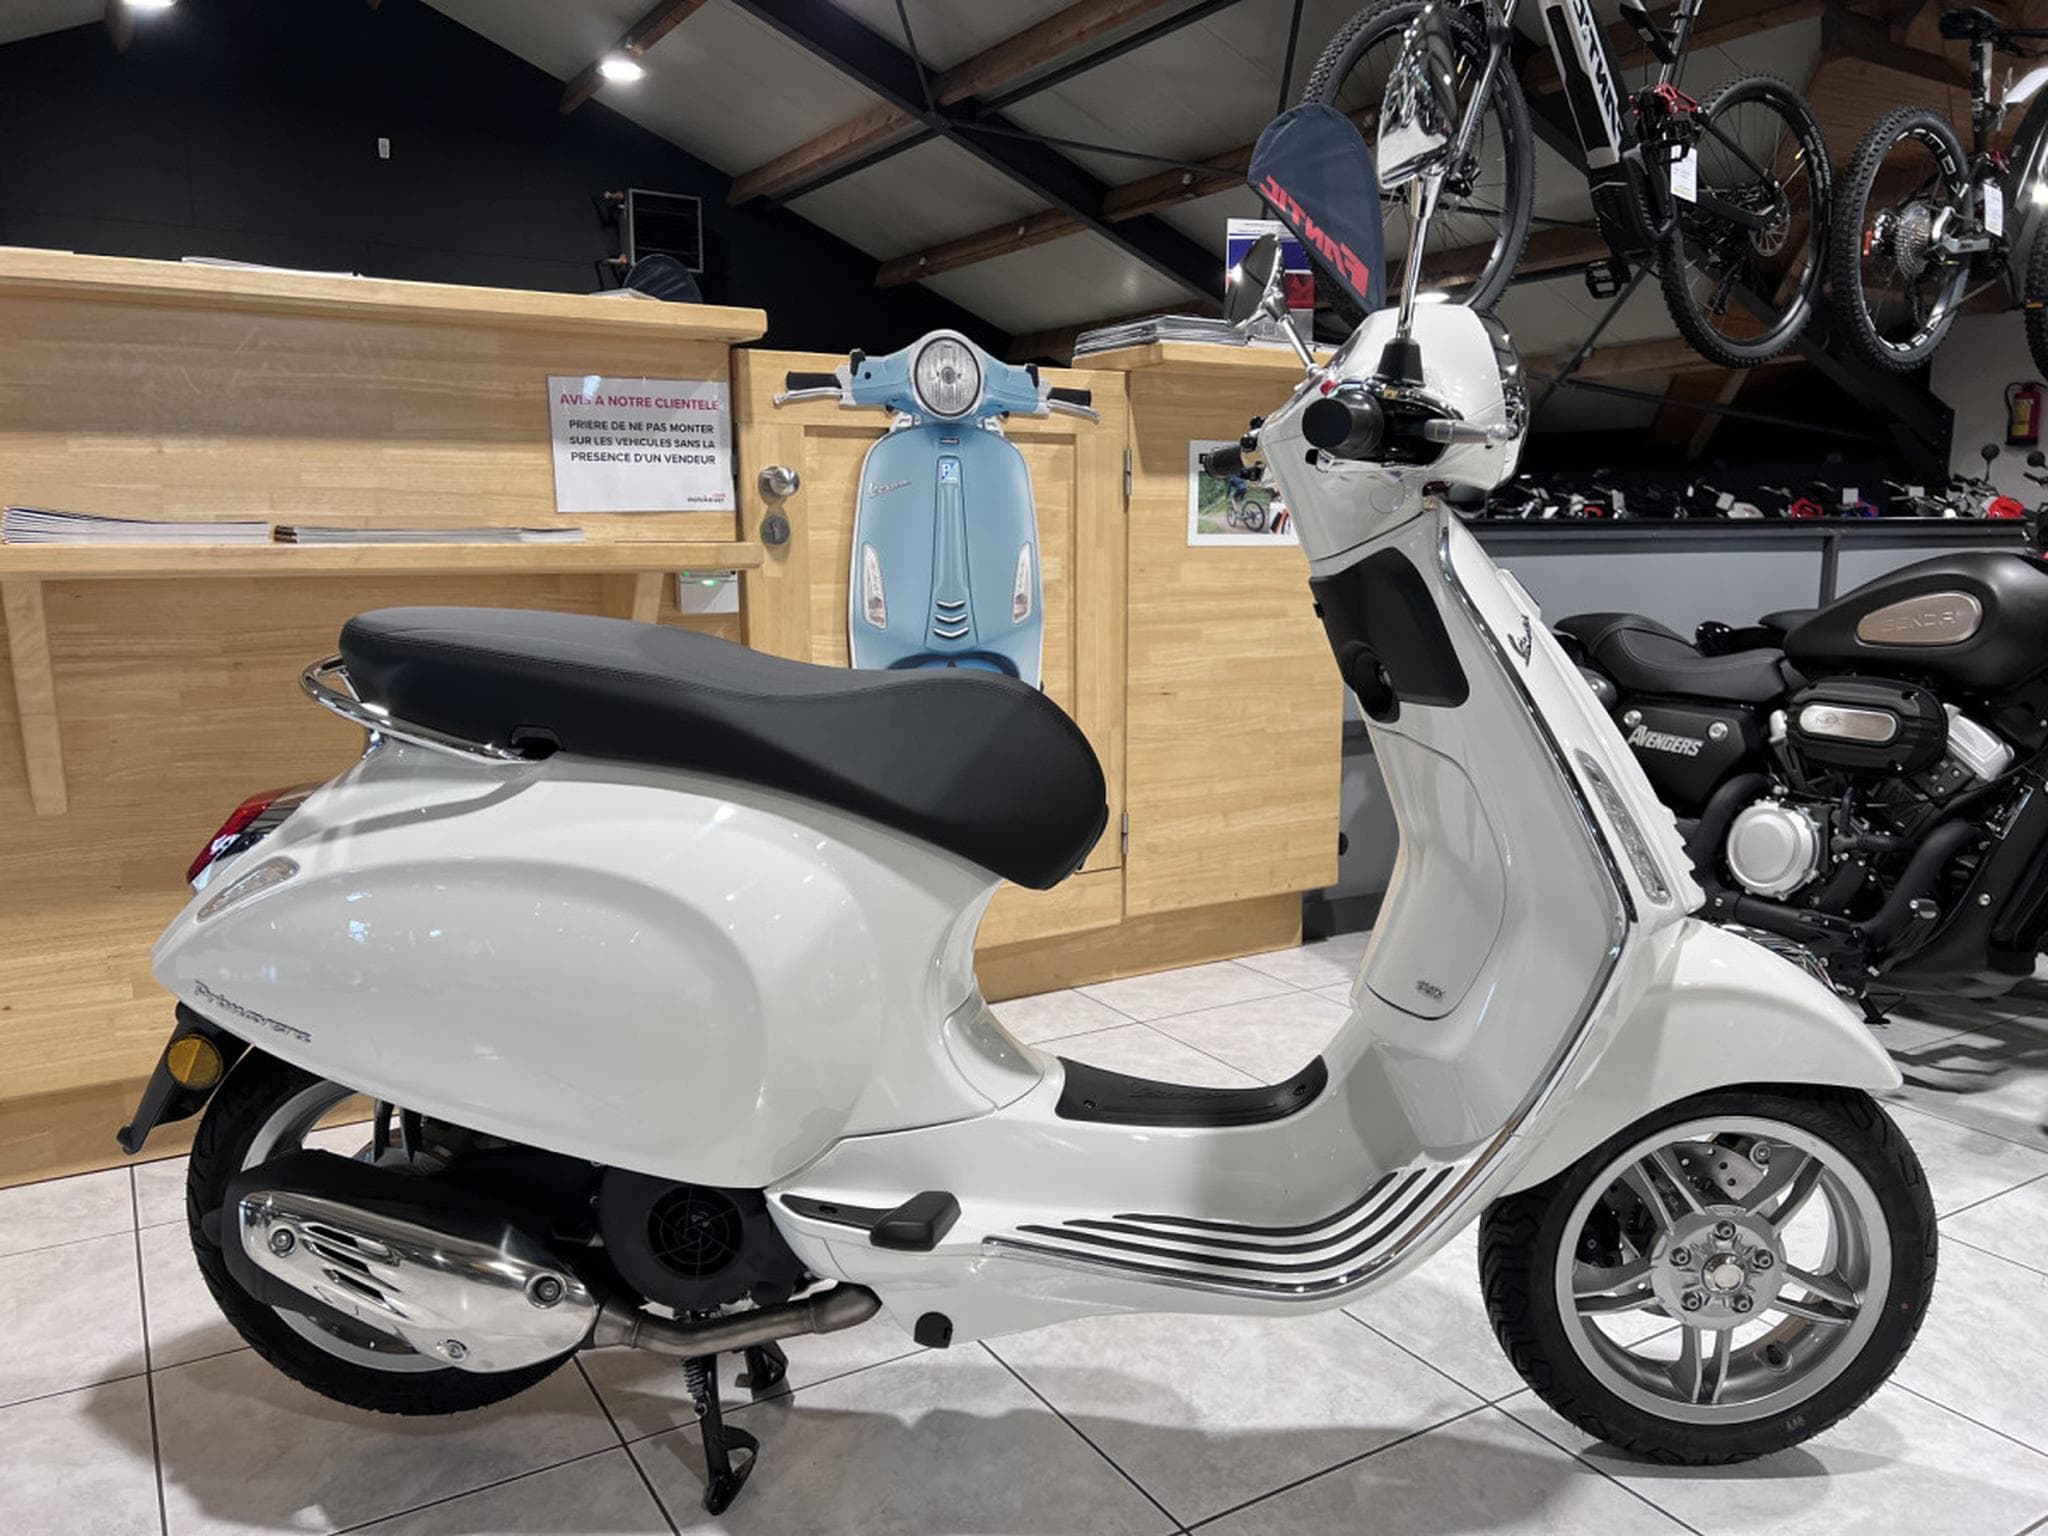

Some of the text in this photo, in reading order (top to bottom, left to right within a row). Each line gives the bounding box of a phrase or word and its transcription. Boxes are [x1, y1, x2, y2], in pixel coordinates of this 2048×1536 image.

[560, 393, 720, 411] AVIS A NOTRE CLIENTELE
[568, 419, 715, 434] PRIERE DE NE PAS MONTER
[568, 435, 716, 449] SUR LES VEHICULES SANS LA
[570, 451, 717, 465] PRESENCE D'UN VENDEUR
[1627, 724, 1705, 757] AVENGERS
